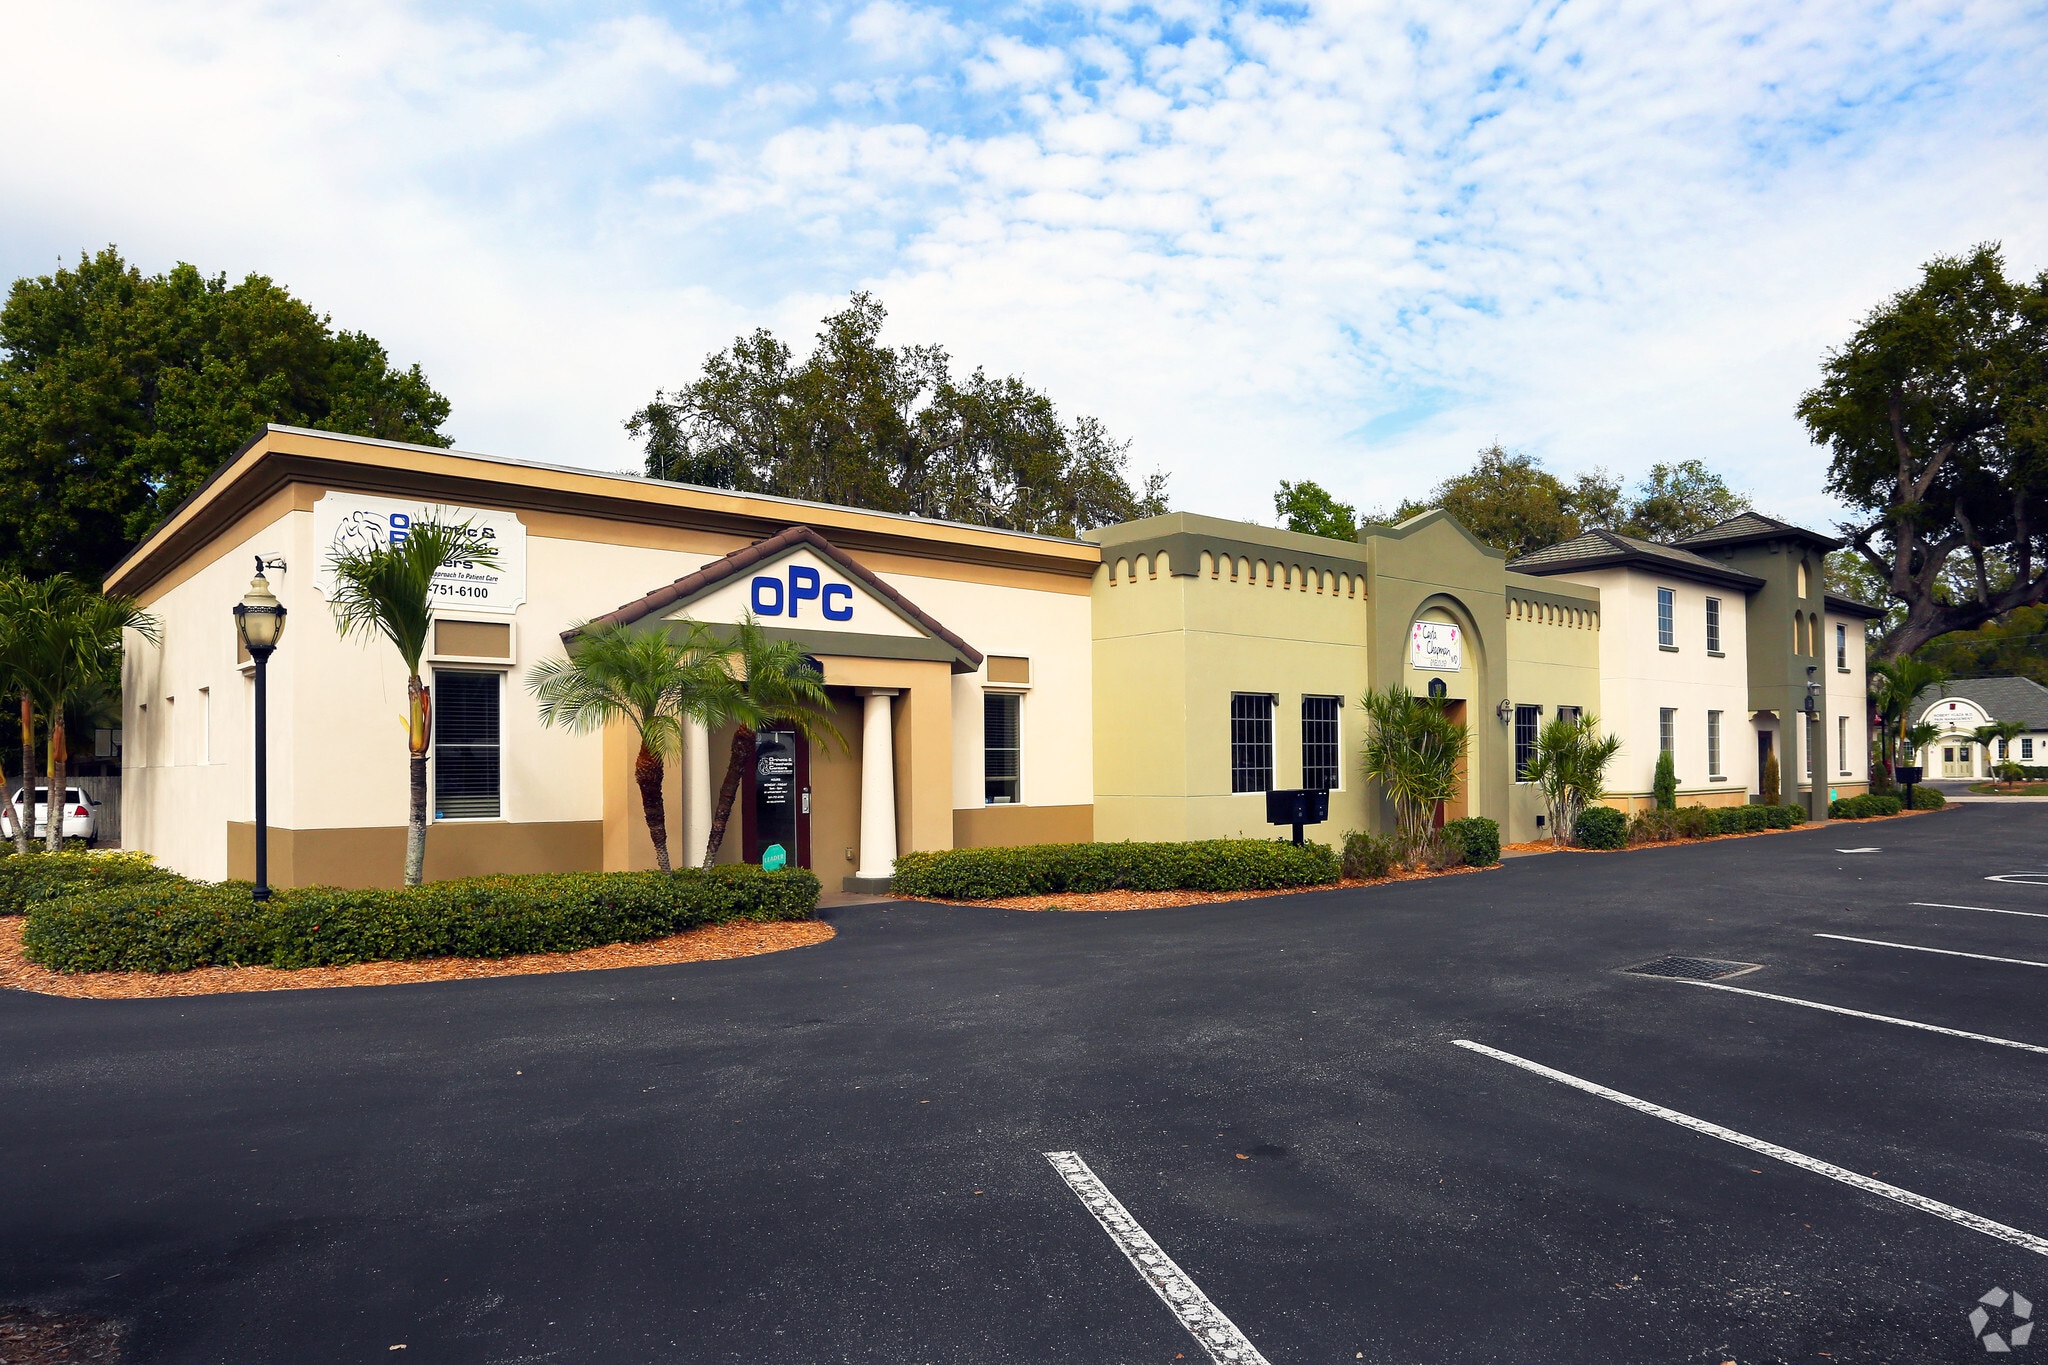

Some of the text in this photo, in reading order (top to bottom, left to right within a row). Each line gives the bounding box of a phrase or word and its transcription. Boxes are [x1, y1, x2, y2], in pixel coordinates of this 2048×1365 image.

[482, 527, 496, 539] &
[434, 571, 457, 579] pproach
[465, 573, 485, 581] Patient
[486, 574, 499, 582] Care
[429, 584, 488, 598] -751-6100
